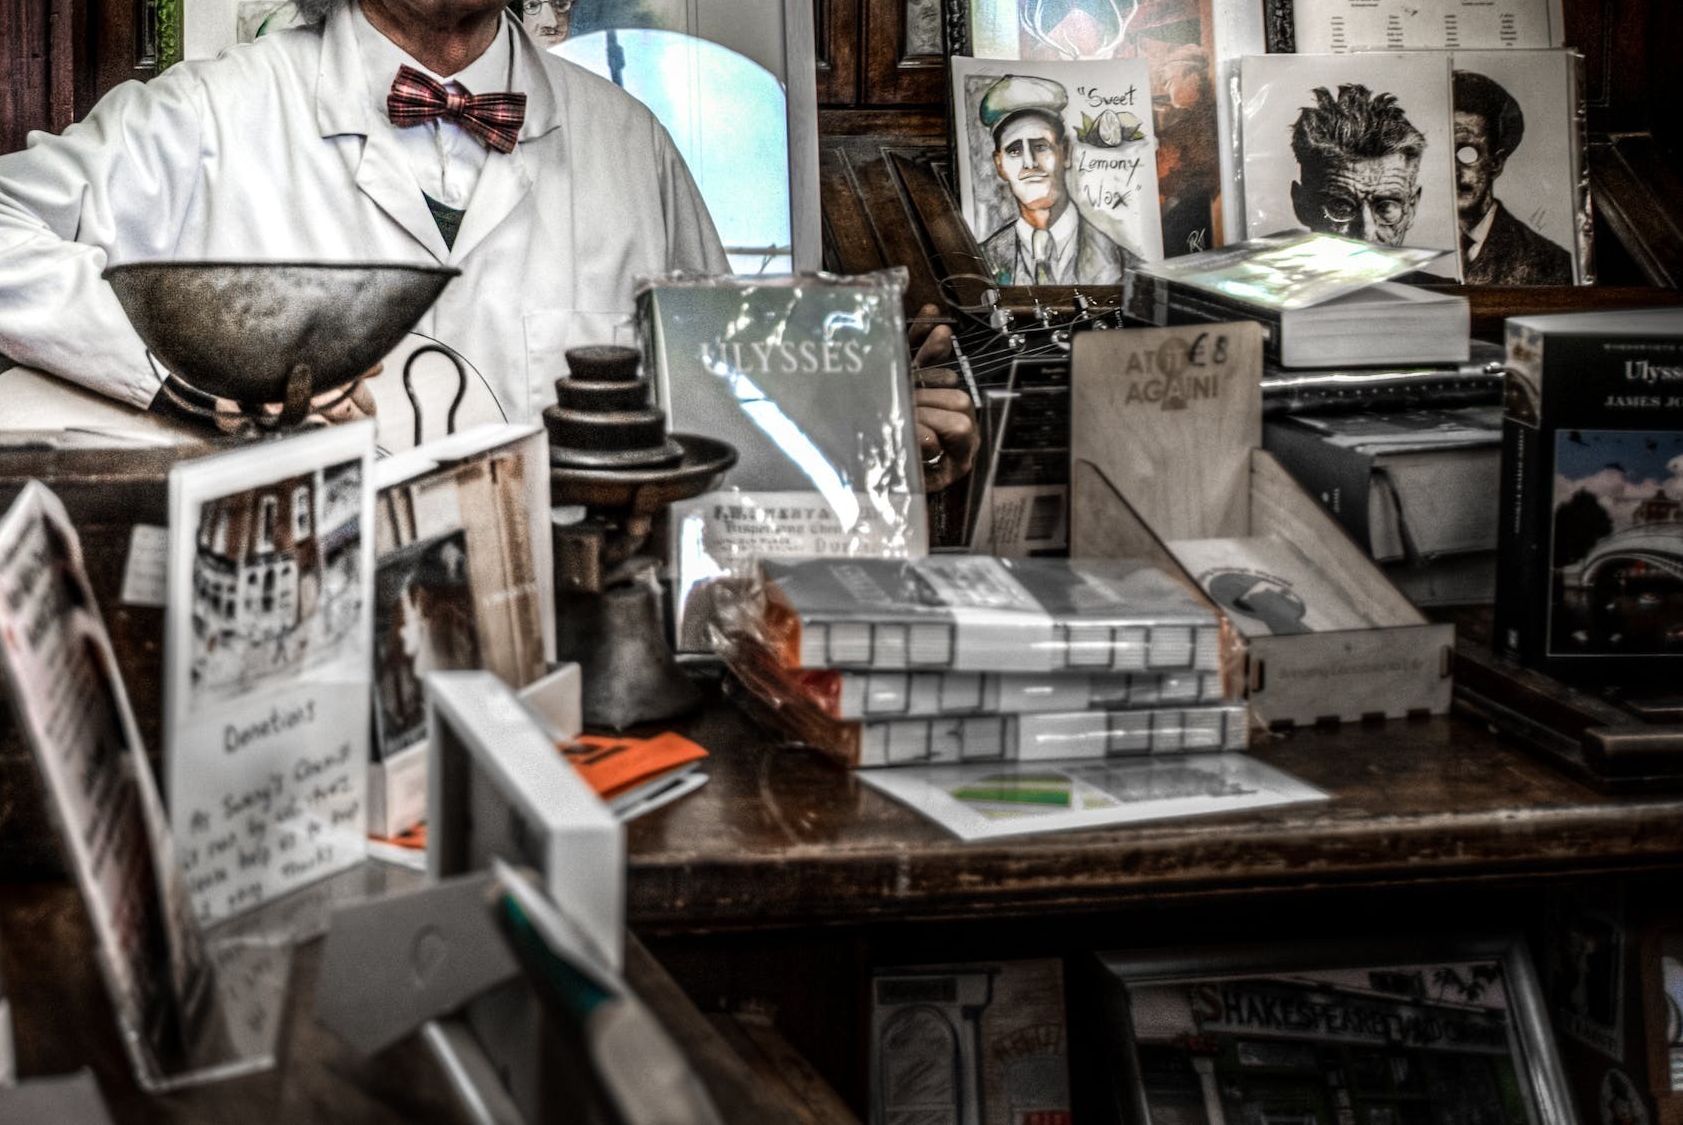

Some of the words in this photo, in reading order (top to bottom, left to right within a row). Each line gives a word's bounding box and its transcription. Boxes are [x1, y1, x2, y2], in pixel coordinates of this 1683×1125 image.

[1078, 150, 1141, 187] Lemony
[701, 340, 865, 374] ULYSSES
[1604, 395, 1662, 407] JAMES
